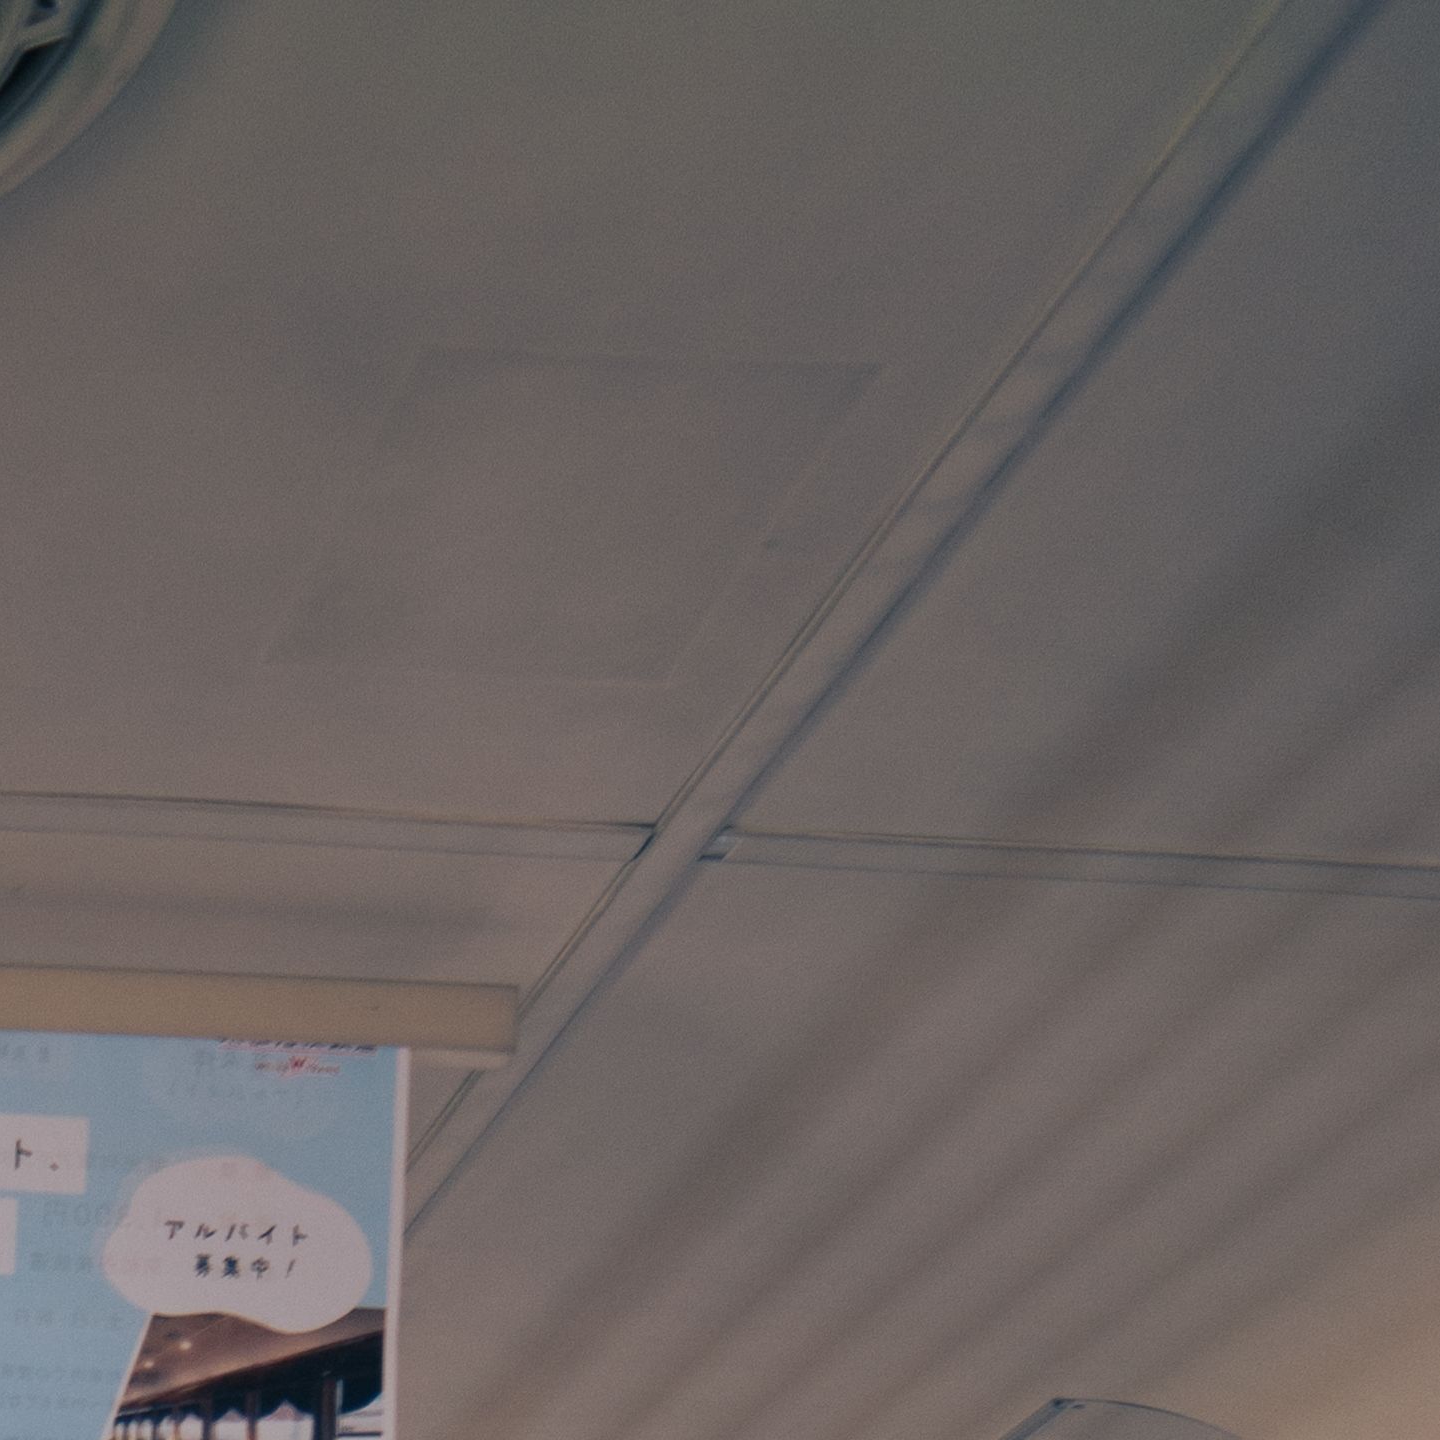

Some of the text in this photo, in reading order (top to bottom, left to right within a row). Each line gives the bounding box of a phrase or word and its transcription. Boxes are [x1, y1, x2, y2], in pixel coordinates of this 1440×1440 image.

[165, 1219, 308, 1247] アルバイト
